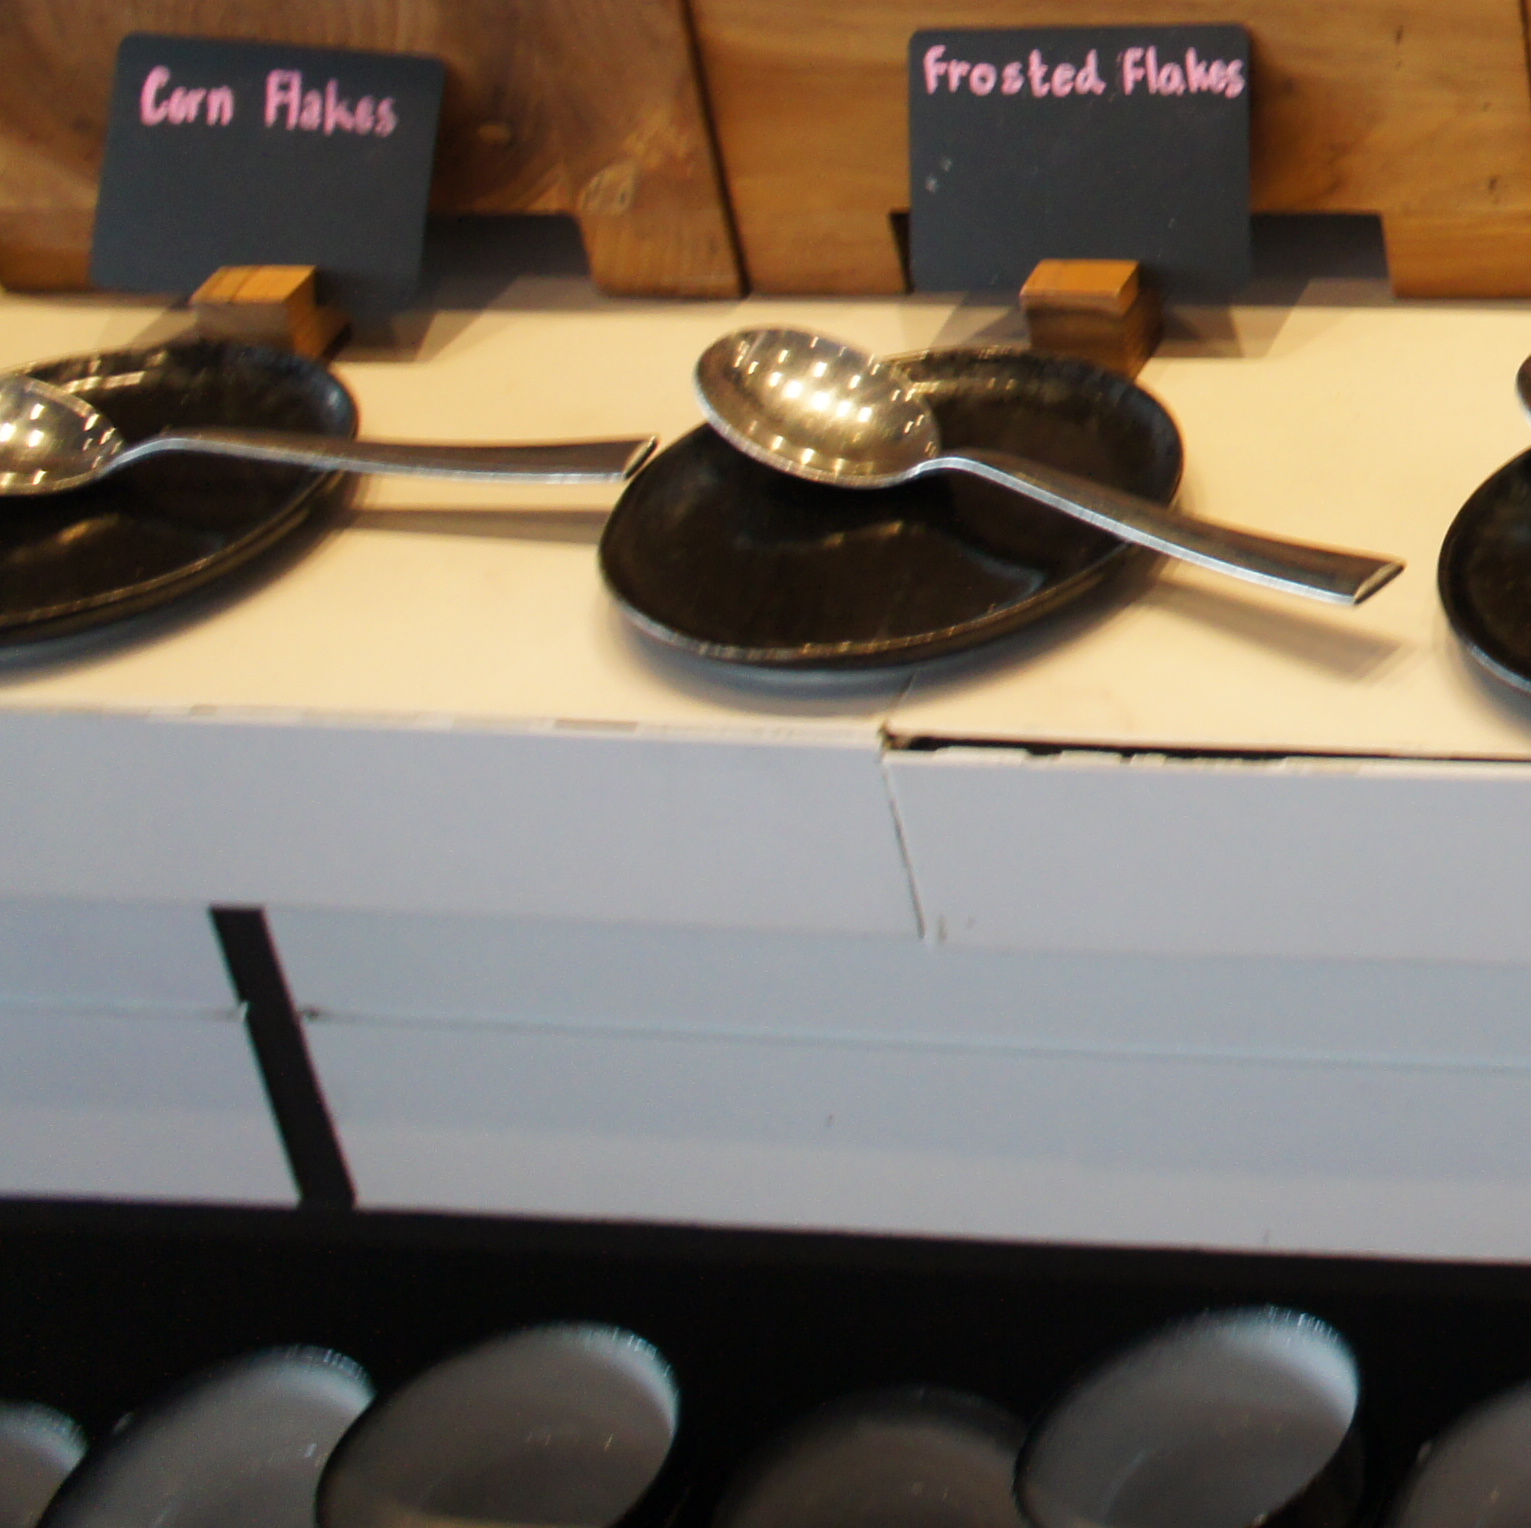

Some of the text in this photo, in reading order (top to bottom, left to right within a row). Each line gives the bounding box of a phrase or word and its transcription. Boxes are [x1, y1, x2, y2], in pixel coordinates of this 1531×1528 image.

[140, 64, 398, 137] Corn Flakes
[922, 44, 1246, 99] Frosted Flakes
